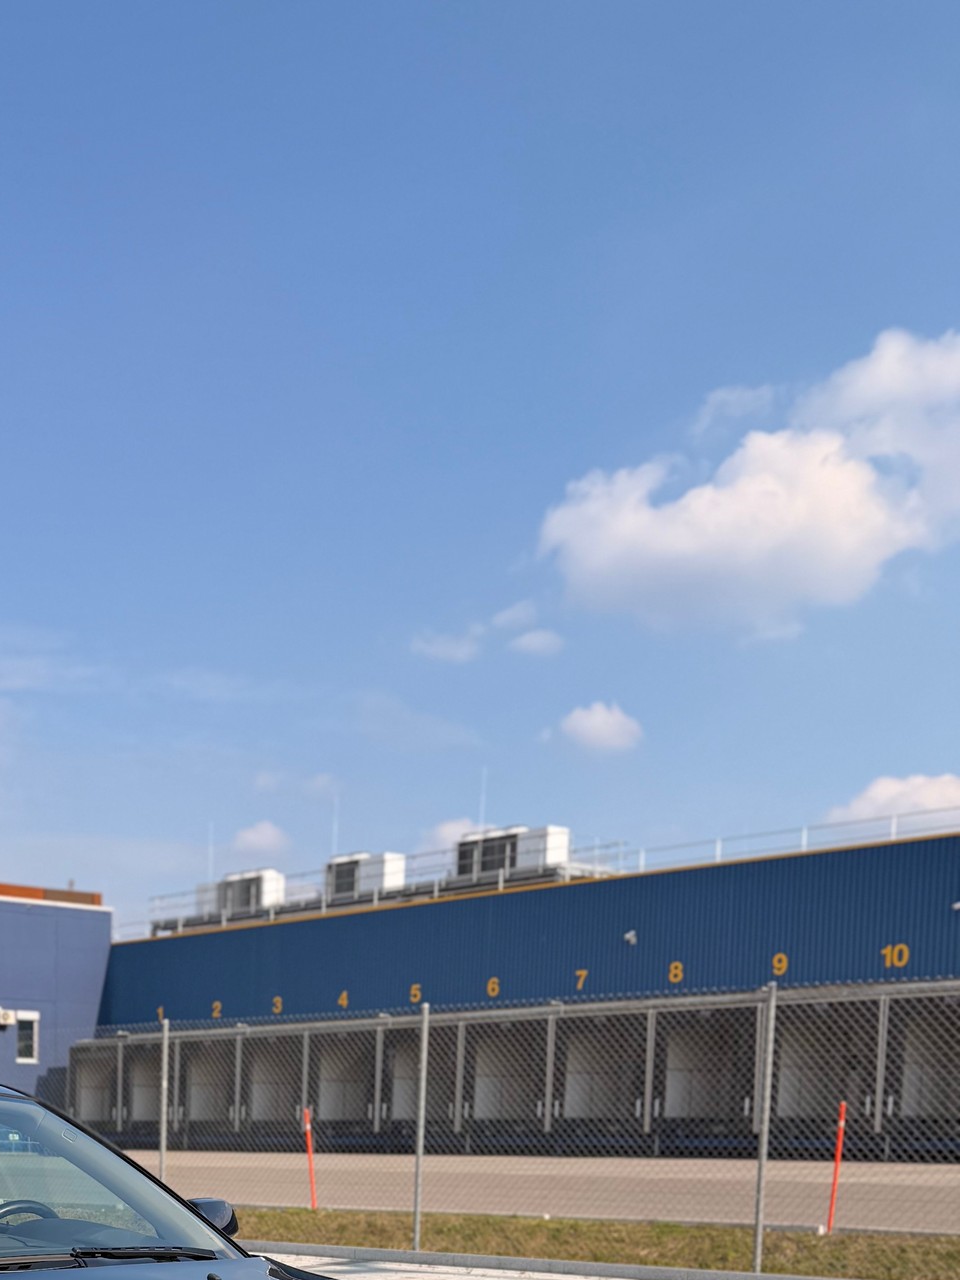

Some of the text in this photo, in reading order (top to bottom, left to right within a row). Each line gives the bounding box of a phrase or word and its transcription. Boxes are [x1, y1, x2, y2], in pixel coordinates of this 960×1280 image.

[771, 952, 789, 976] 9
[880, 943, 910, 968] 10
[575, 969, 588, 990] 7
[668, 961, 684, 984] 8
[409, 983, 422, 1003] 5
[486, 976, 500, 997] 6
[212, 1000, 222, 1019] 2
[272, 996, 283, 1014] 3
[337, 990, 349, 1009] 4
[156, 1006, 164, 1024] 1
